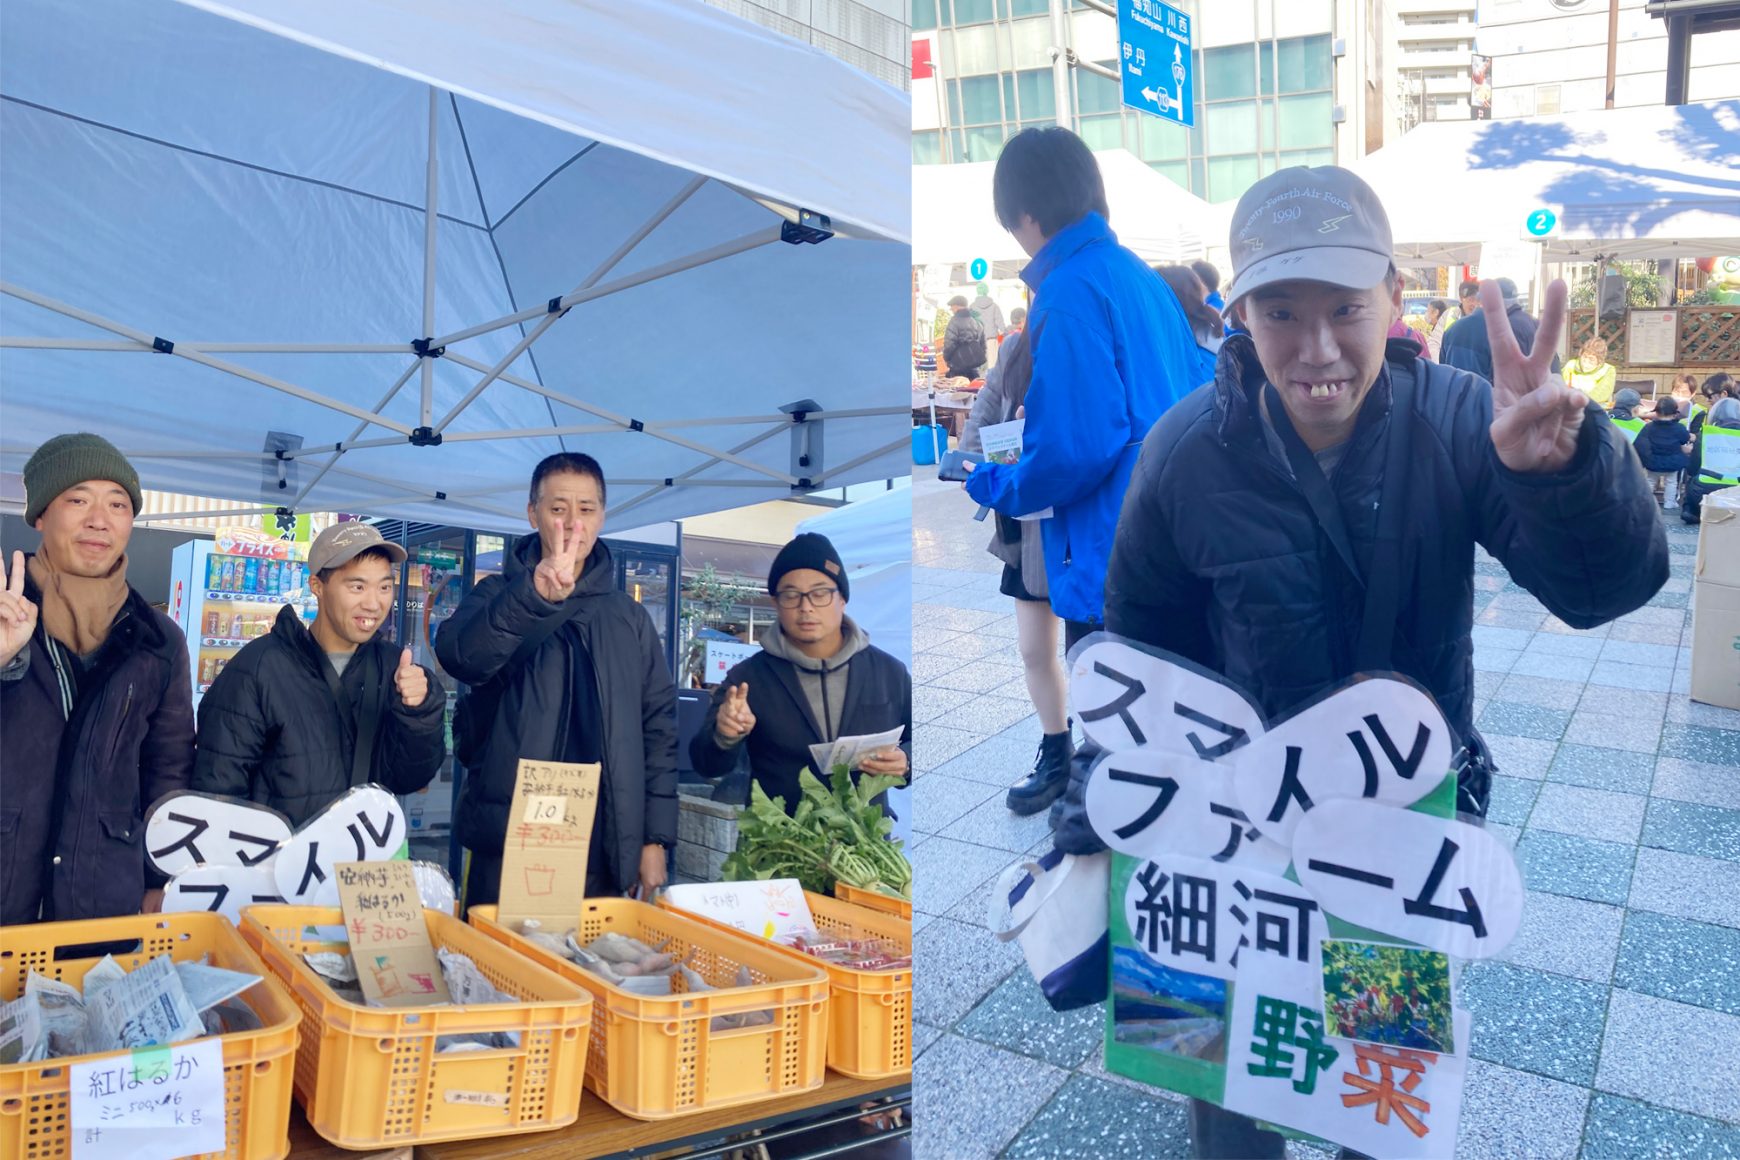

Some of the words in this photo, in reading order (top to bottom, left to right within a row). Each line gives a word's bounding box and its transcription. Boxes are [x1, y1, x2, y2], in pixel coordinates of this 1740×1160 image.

[1167, 10, 1188, 34] 川西
[1123, 41, 1146, 67] 伊丹
[1303, 187, 1322, 199] Air
[1323, 191, 1353, 212] Force
[1272, 206, 1301, 225] 1990
[1535, 214, 1547, 230] 2
[1135, 860, 1319, 969] 細河
[89, 1055, 199, 1099] 紅はるか
[1247, 995, 1438, 1138] 野菜
[85, 1127, 102, 1144] 計
